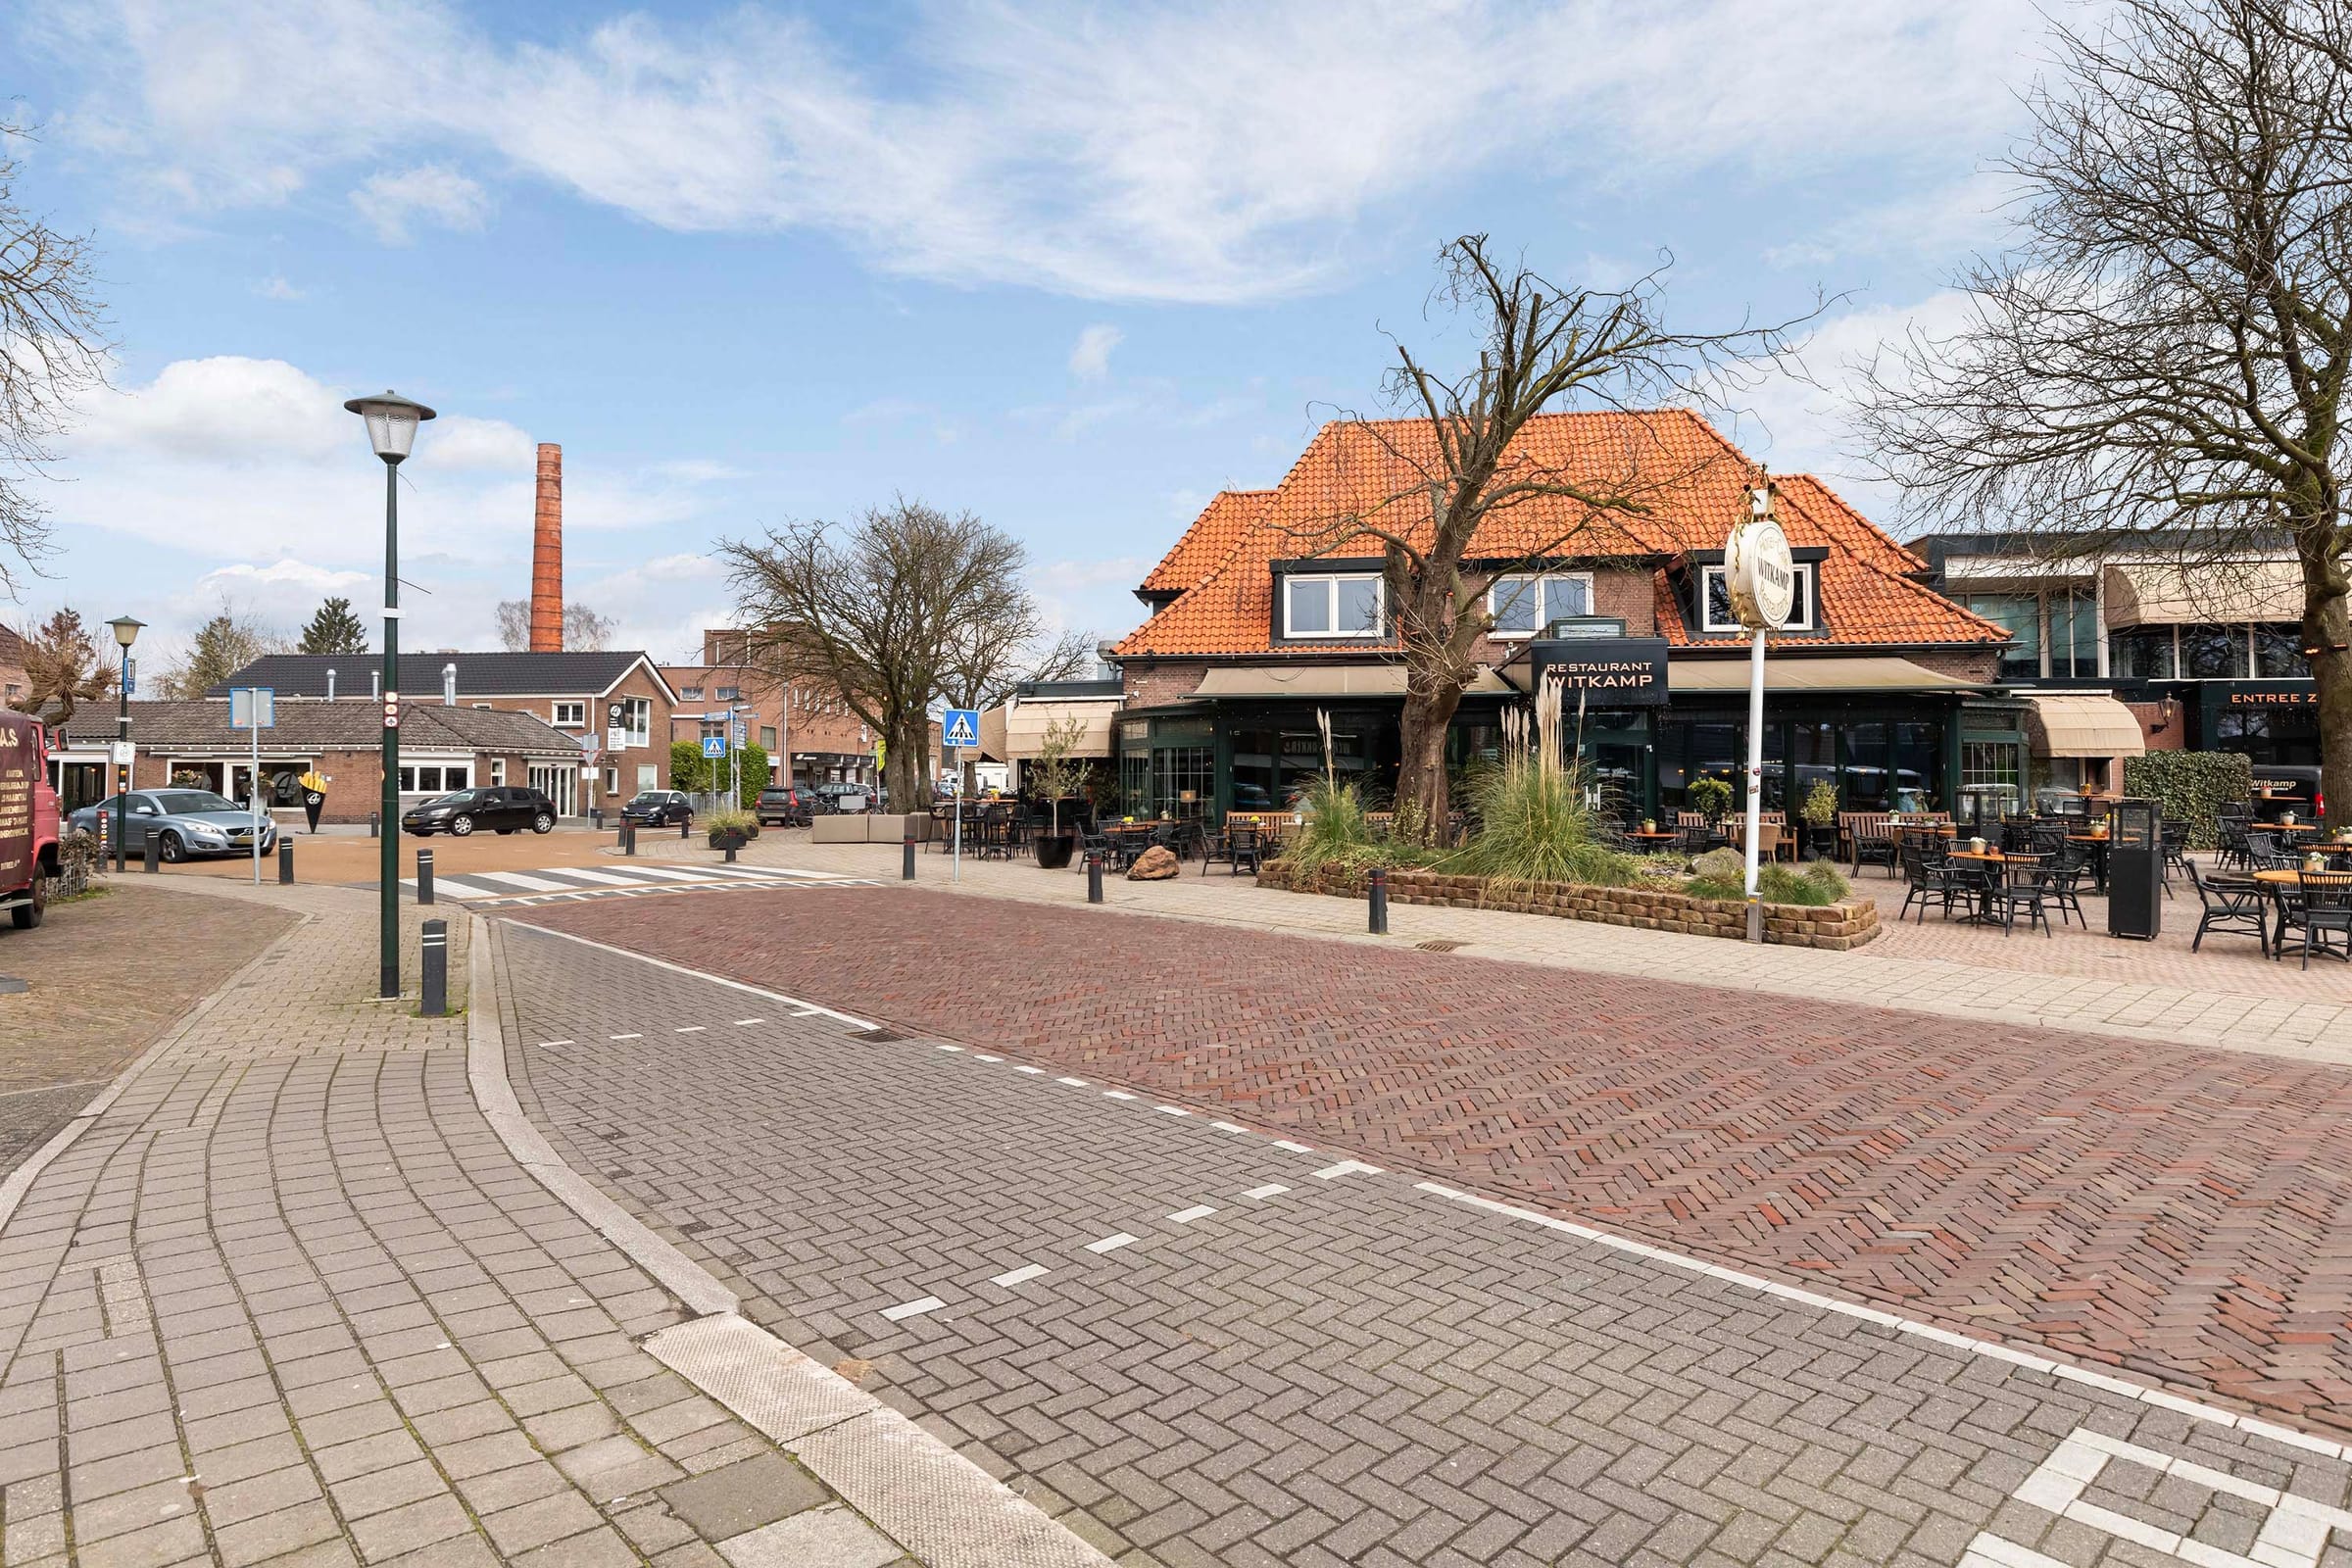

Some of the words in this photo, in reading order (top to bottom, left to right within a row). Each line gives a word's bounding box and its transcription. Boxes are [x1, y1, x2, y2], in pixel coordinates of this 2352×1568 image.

[1758, 557, 1789, 591] WITKAMP
[1546, 662, 1652, 673] RESTAURANT
[1547, 675, 1653, 688] WITKAMP
[2231, 693, 2301, 704] ENTREE
[2307, 693, 2321, 704] Z
[2251, 779, 2297, 789] Witkamp
